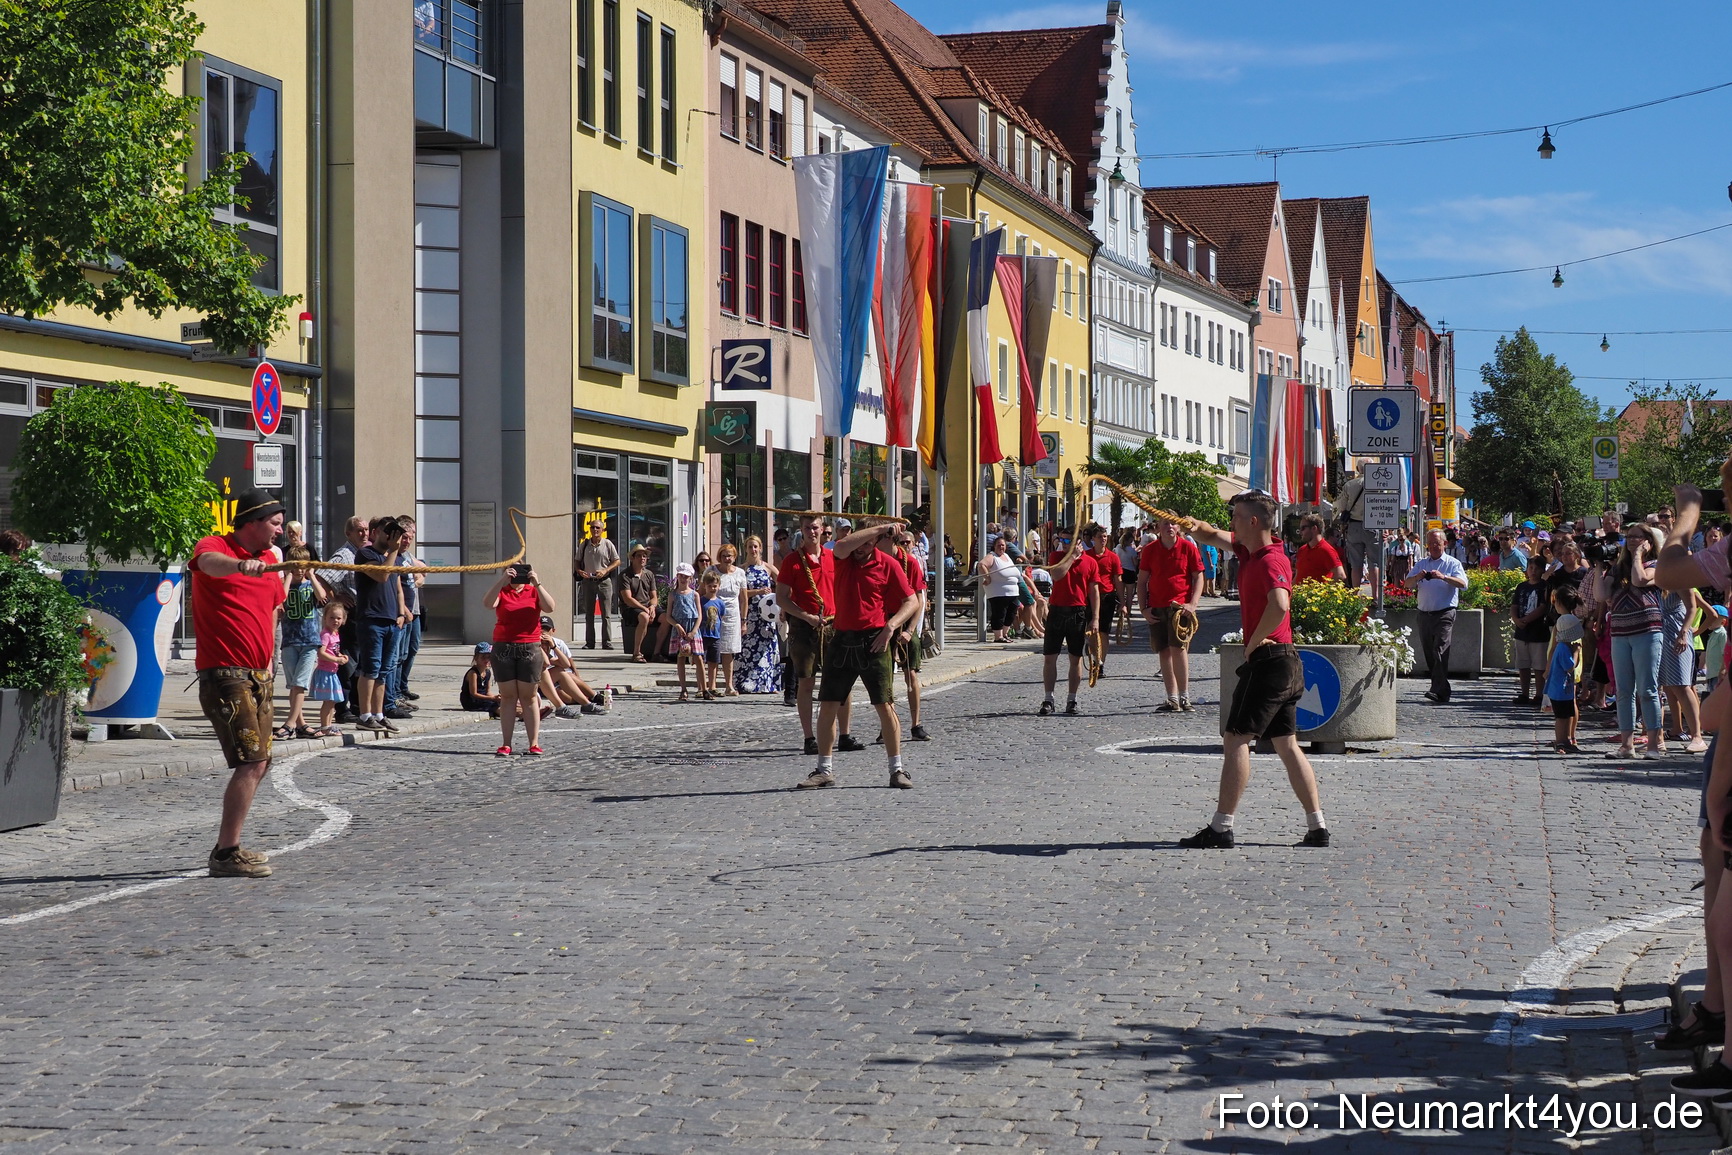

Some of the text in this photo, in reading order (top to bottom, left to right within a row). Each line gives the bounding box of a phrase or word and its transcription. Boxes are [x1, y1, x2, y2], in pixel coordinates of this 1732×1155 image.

[183, 325, 205, 337] Brun
[1367, 437, 1399, 447] ZONE
[1431, 404, 1446, 479] HOTEL
[1376, 480, 1389, 488] frei
[286, 588, 314, 620] 98
